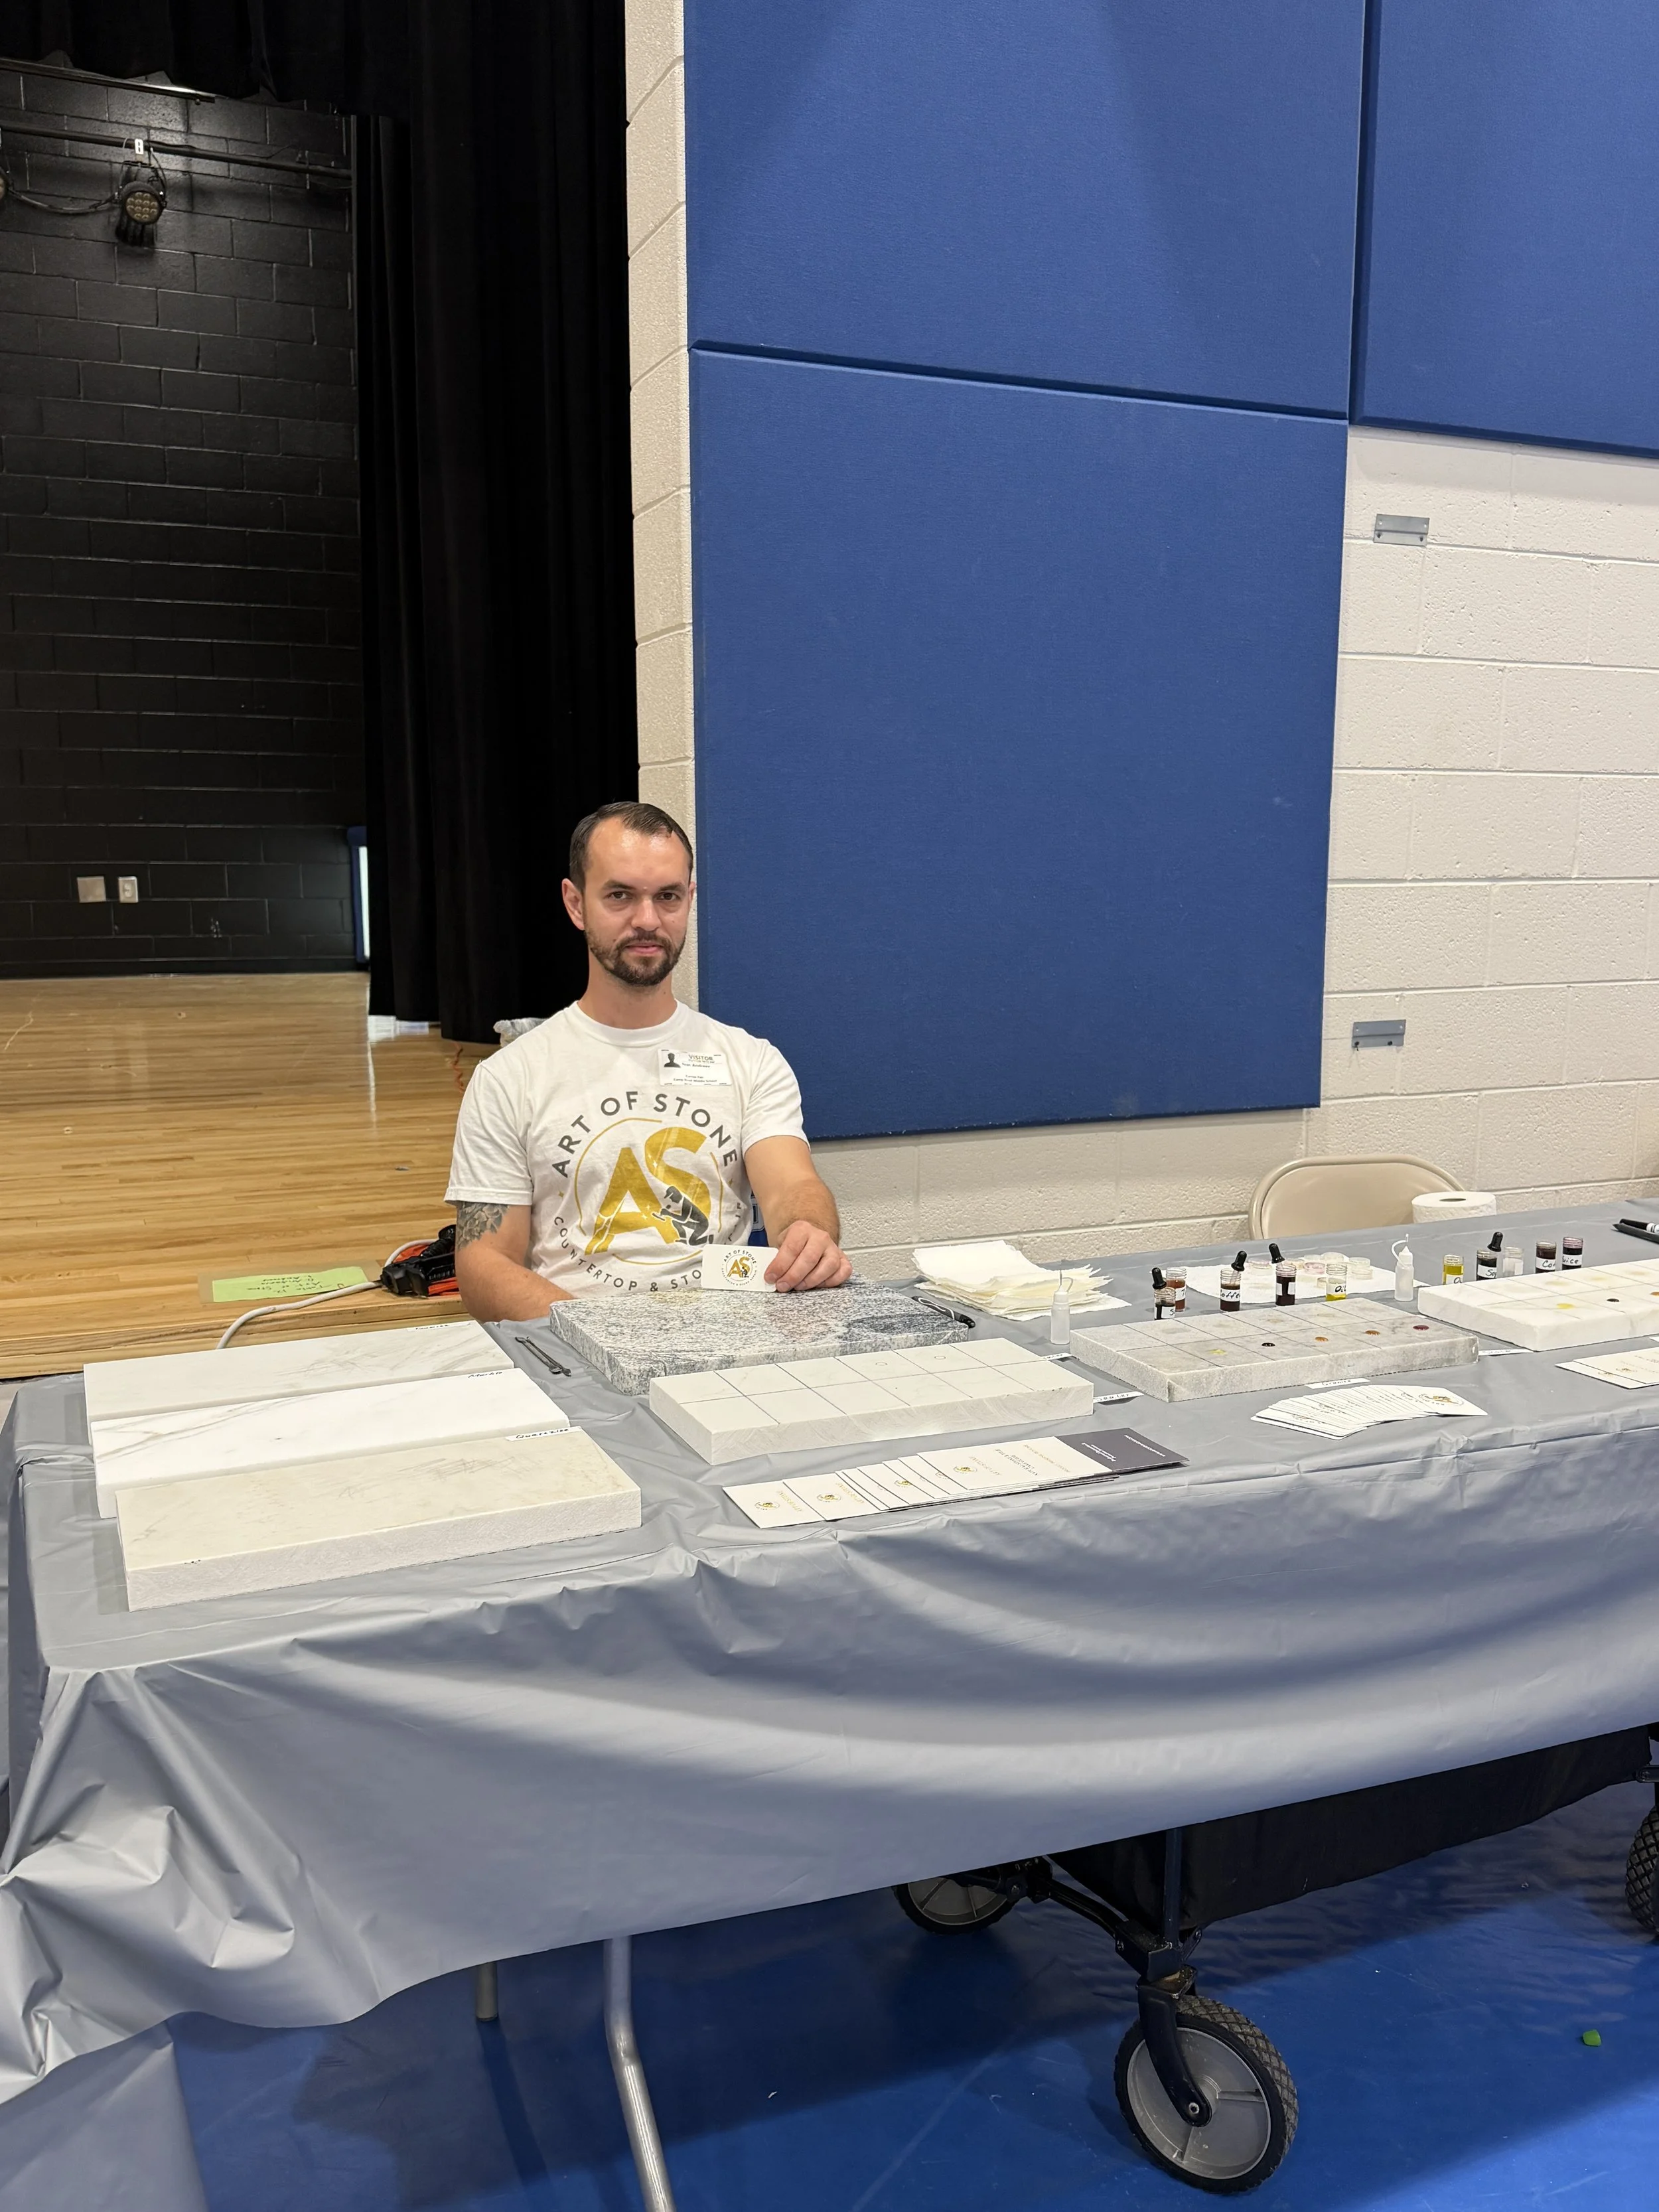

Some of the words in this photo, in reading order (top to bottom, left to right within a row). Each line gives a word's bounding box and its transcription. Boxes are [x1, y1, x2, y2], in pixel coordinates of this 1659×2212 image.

[552, 1115, 591, 1178] ART
[601, 1091, 638, 1116] OF
[654, 1093, 737, 1167] STONE
[585, 1126, 712, 1256] AS
[554, 1217, 638, 1291] COUNTERTOP
[650, 1282, 659, 1292] &
[671, 1270, 701, 1290] STO
[723, 1252, 732, 1262] ART
[743, 1250, 757, 1264] STONE
[727, 1256, 751, 1278] AS
[1220, 1289, 1240, 1299] offe
